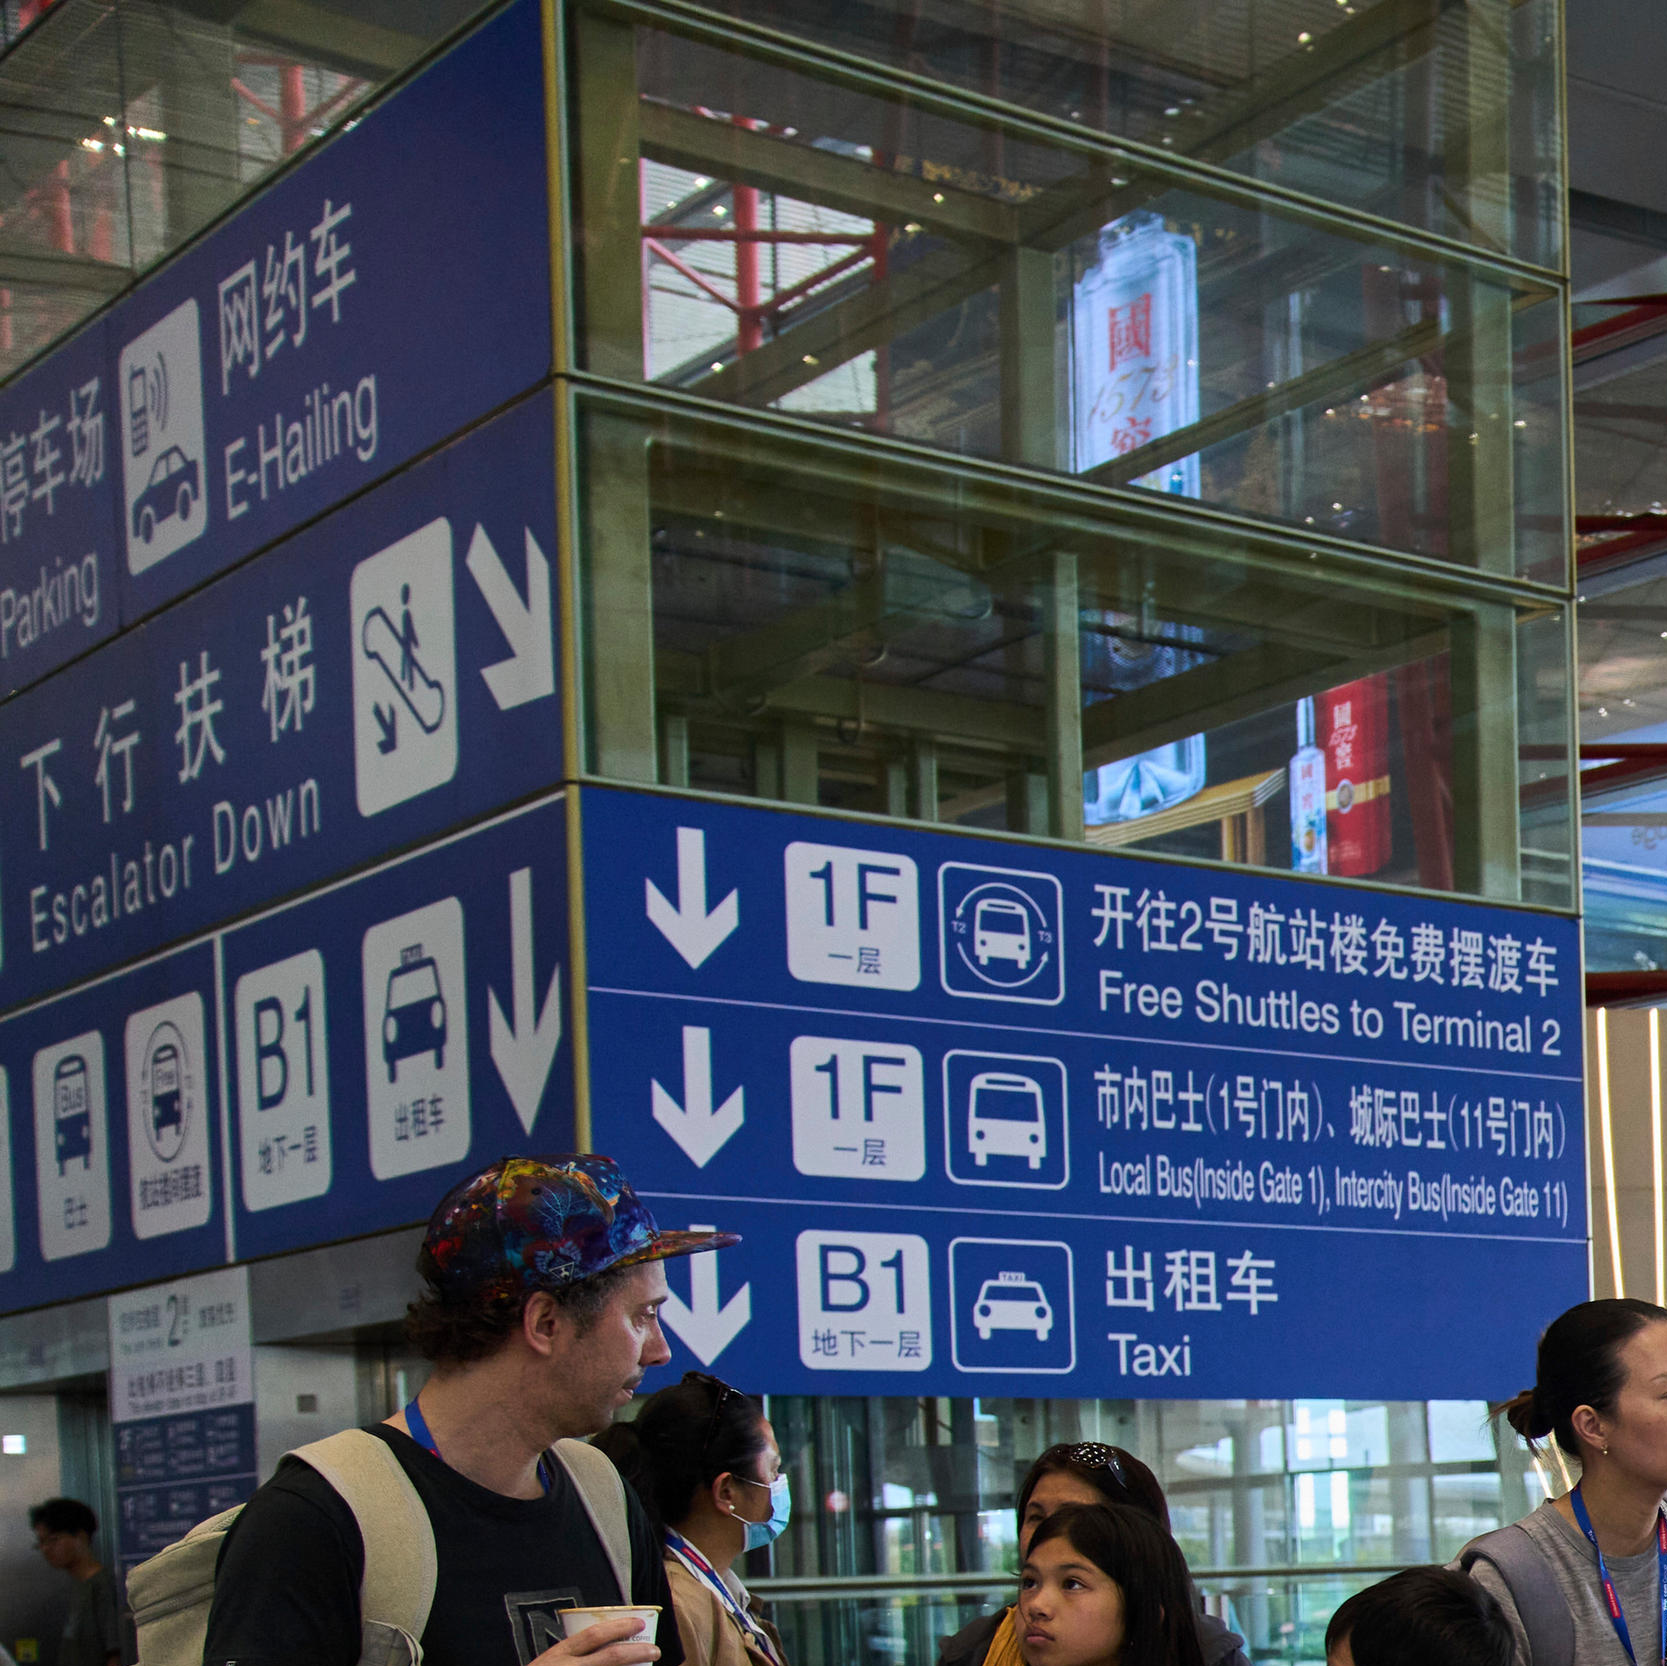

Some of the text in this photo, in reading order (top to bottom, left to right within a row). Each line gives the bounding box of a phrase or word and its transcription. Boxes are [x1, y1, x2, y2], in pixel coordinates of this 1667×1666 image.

[218, 199, 357, 396] 网约车
[1087, 353, 1180, 431] 1573
[0, 377, 105, 544] 停车场
[225, 373, 378, 521] E-Hailing
[1, 552, 99, 659] Parking
[20, 596, 316, 850] 下行扶梯
[30, 778, 321, 953] Escalator Down
[808, 859, 902, 931] 1F
[827, 945, 883, 976] 一层
[1091, 883, 1560, 998] 开往2号航站楼免费摆渡车
[253, 984, 315, 1112] B1
[1098, 969, 1562, 1056] Free Shuttles to Terminal 2
[395, 1093, 445, 1141] 出租车
[814, 1053, 907, 1122] 1F
[832, 1137, 888, 1167] 一层
[1098, 1150, 1151, 1196] Local
[1156, 1153, 1255, 1208] Bus(Inside
[1259, 1161, 1303, 1204] Gate
[1335, 1165, 1402, 1220] Intercity
[1408, 1170, 1496, 1222] Bus(Inside
[1500, 1175, 1540, 1218] Gate
[1543, 1180, 1568, 1229] 11)
[818, 1243, 906, 1314] B1
[1106, 1244, 1279, 1316] 出租车
[810, 1329, 922, 1360] 地下一层
[1107, 1332, 1192, 1377] Taxi
